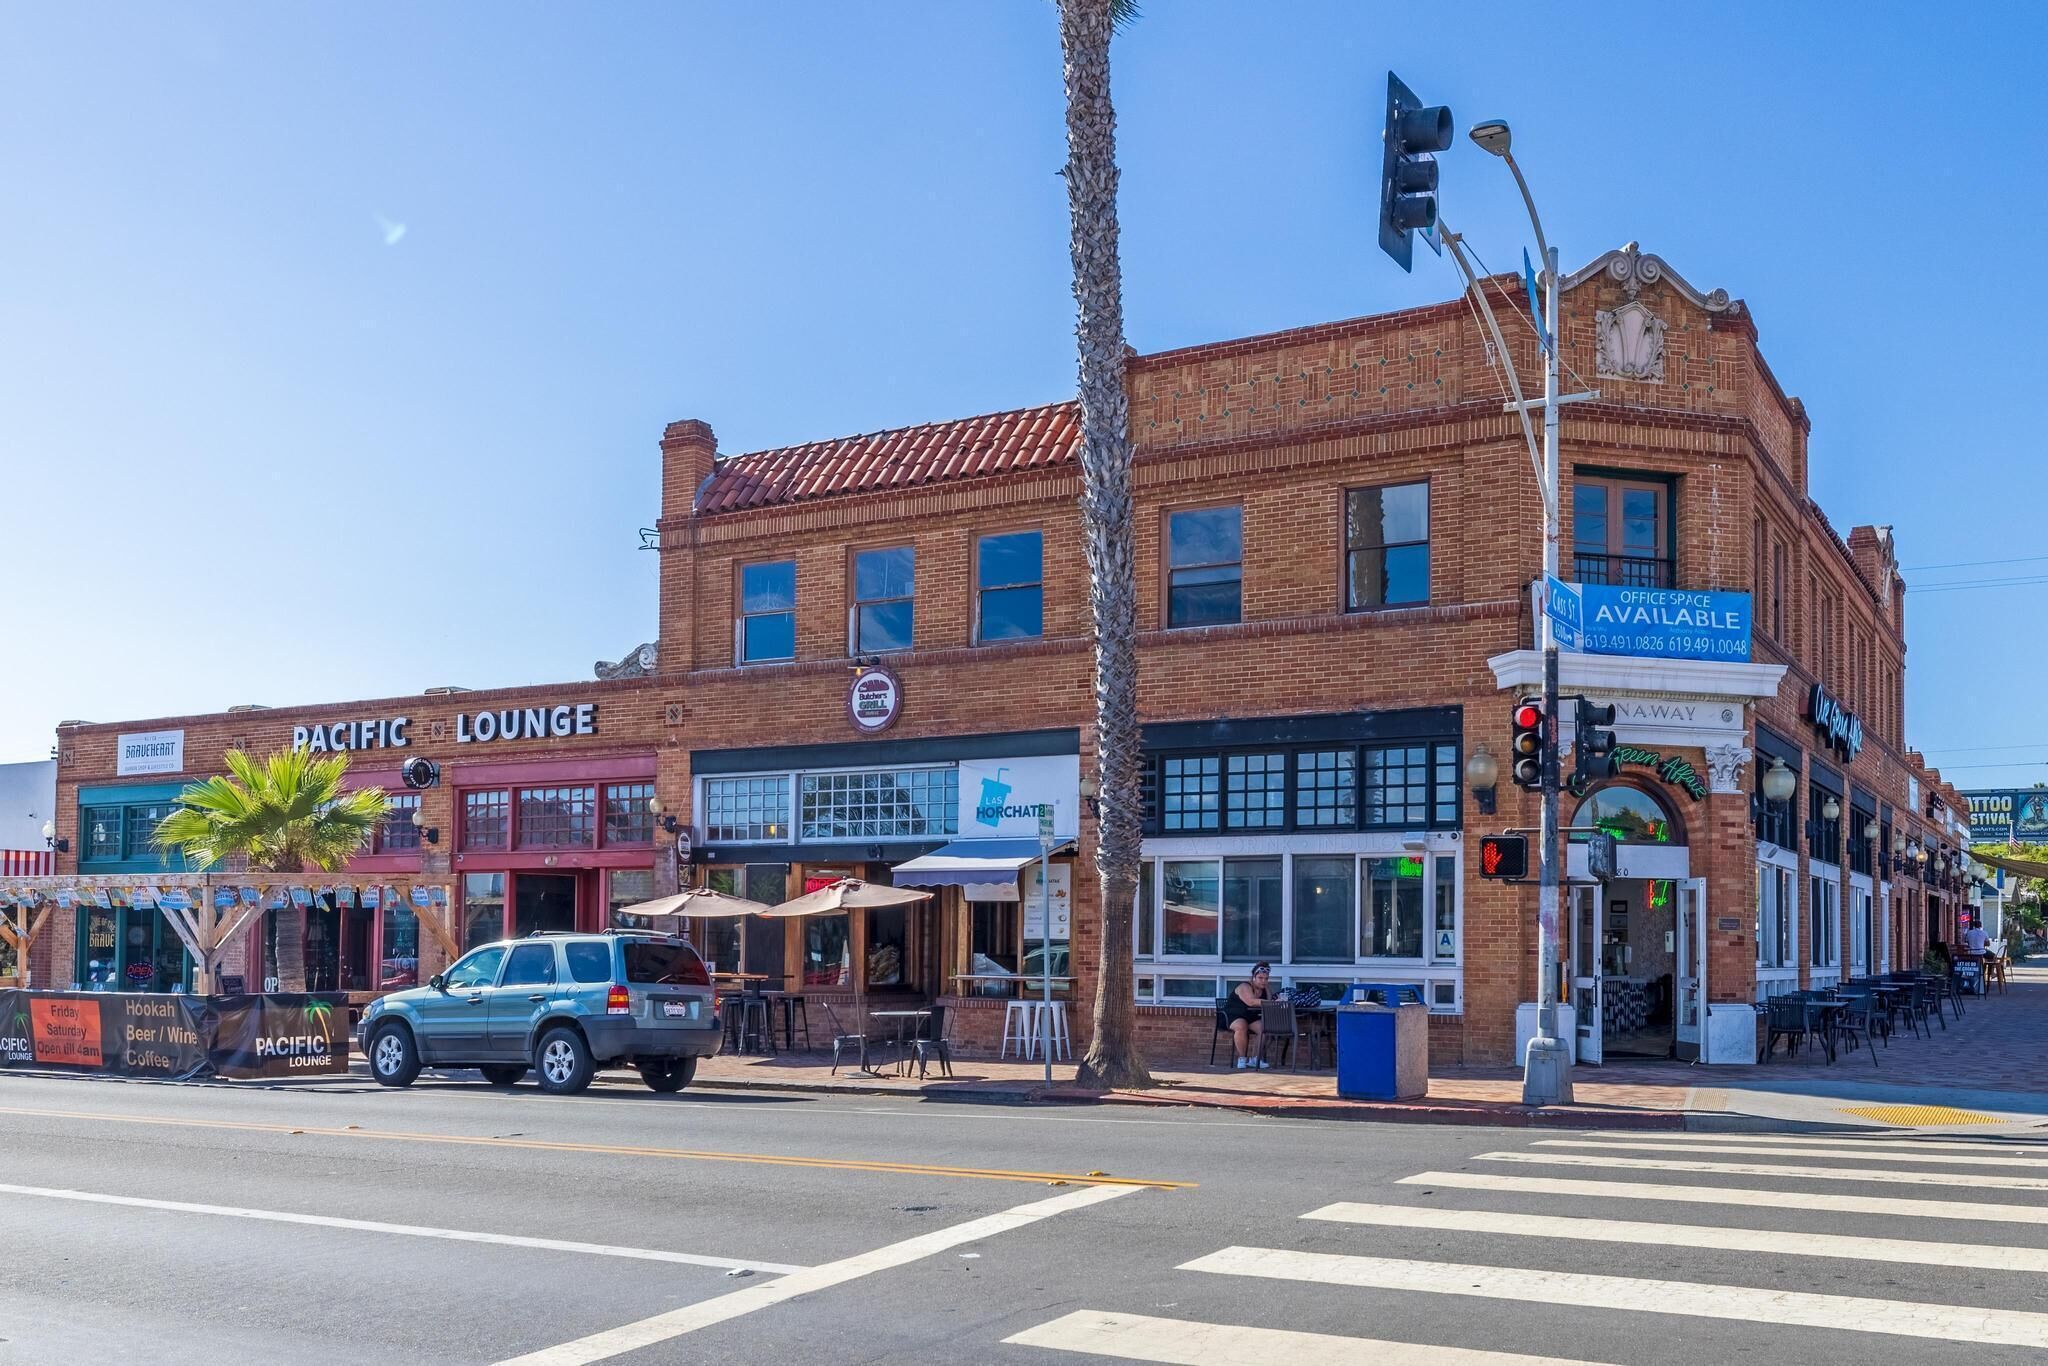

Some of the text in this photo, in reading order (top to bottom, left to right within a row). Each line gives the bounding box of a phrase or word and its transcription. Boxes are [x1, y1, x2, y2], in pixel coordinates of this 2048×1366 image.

[1620, 590, 1711, 608] OFFICE SPACE
[1595, 604, 1741, 629] AVAILABLE
[1584, 634, 1748, 655] 619.491.0826 619.491.0048
[859, 700, 888, 710] GRILL
[292, 703, 597, 753] PACIFIC LOUNGE
[985, 796, 1003, 805] LAS
[976, 804, 1040, 819] HORCHAT
[1970, 812, 2011, 825] STIVAL
[1315, 833, 1398, 852] INDULG
[89, 933, 115, 948] BRAVE
[1440, 933, 1450, 946] A
[263, 976, 280, 993] OP
[50, 1004, 80, 1020] Friday
[125, 999, 176, 1018] Hookah
[46, 1023, 87, 1040] Saturday
[126, 1024, 157, 1042] Beer
[167, 1026, 198, 1045] Wine
[37, 1041, 62, 1058] Open
[63, 1042, 75, 1056] till
[255, 1035, 325, 1057] PACIFIC
[8, 1052, 33, 1061] LOUNGE
[126, 1049, 170, 1068] Coffee
[289, 1054, 332, 1068] LOUNGE
